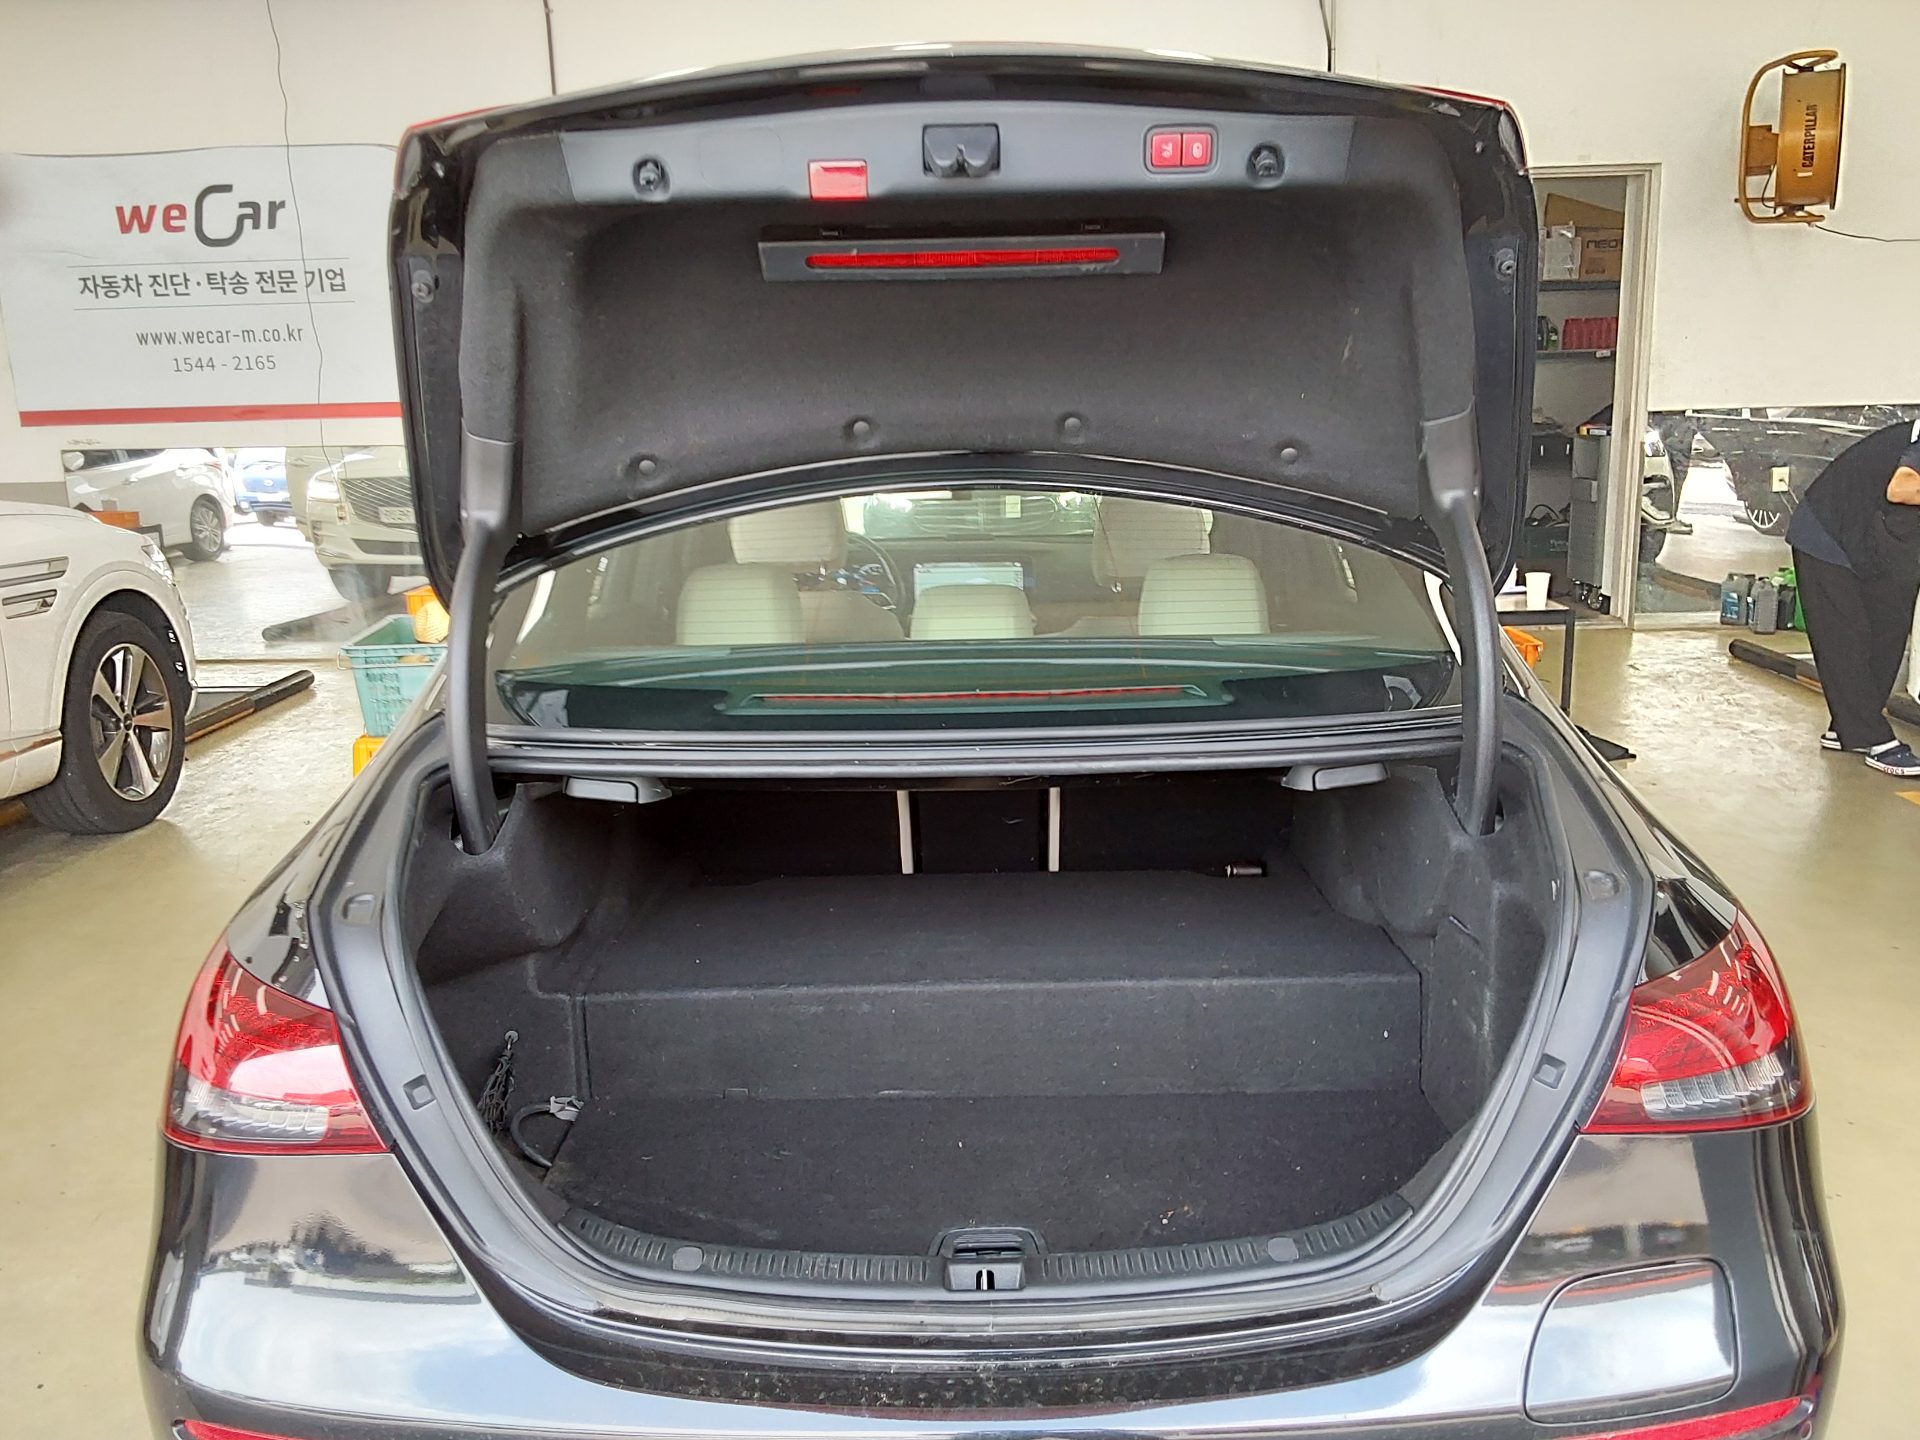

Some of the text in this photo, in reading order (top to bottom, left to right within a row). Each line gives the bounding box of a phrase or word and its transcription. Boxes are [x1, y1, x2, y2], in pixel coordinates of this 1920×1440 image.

[1802, 104, 1818, 168] CATERPILLAR
[78, 274, 143, 300] 자동차
[255, 269, 298, 294] 전문
[304, 268, 346, 293] 기업
[136, 323, 303, 346] www.wecar-m.co.kr
